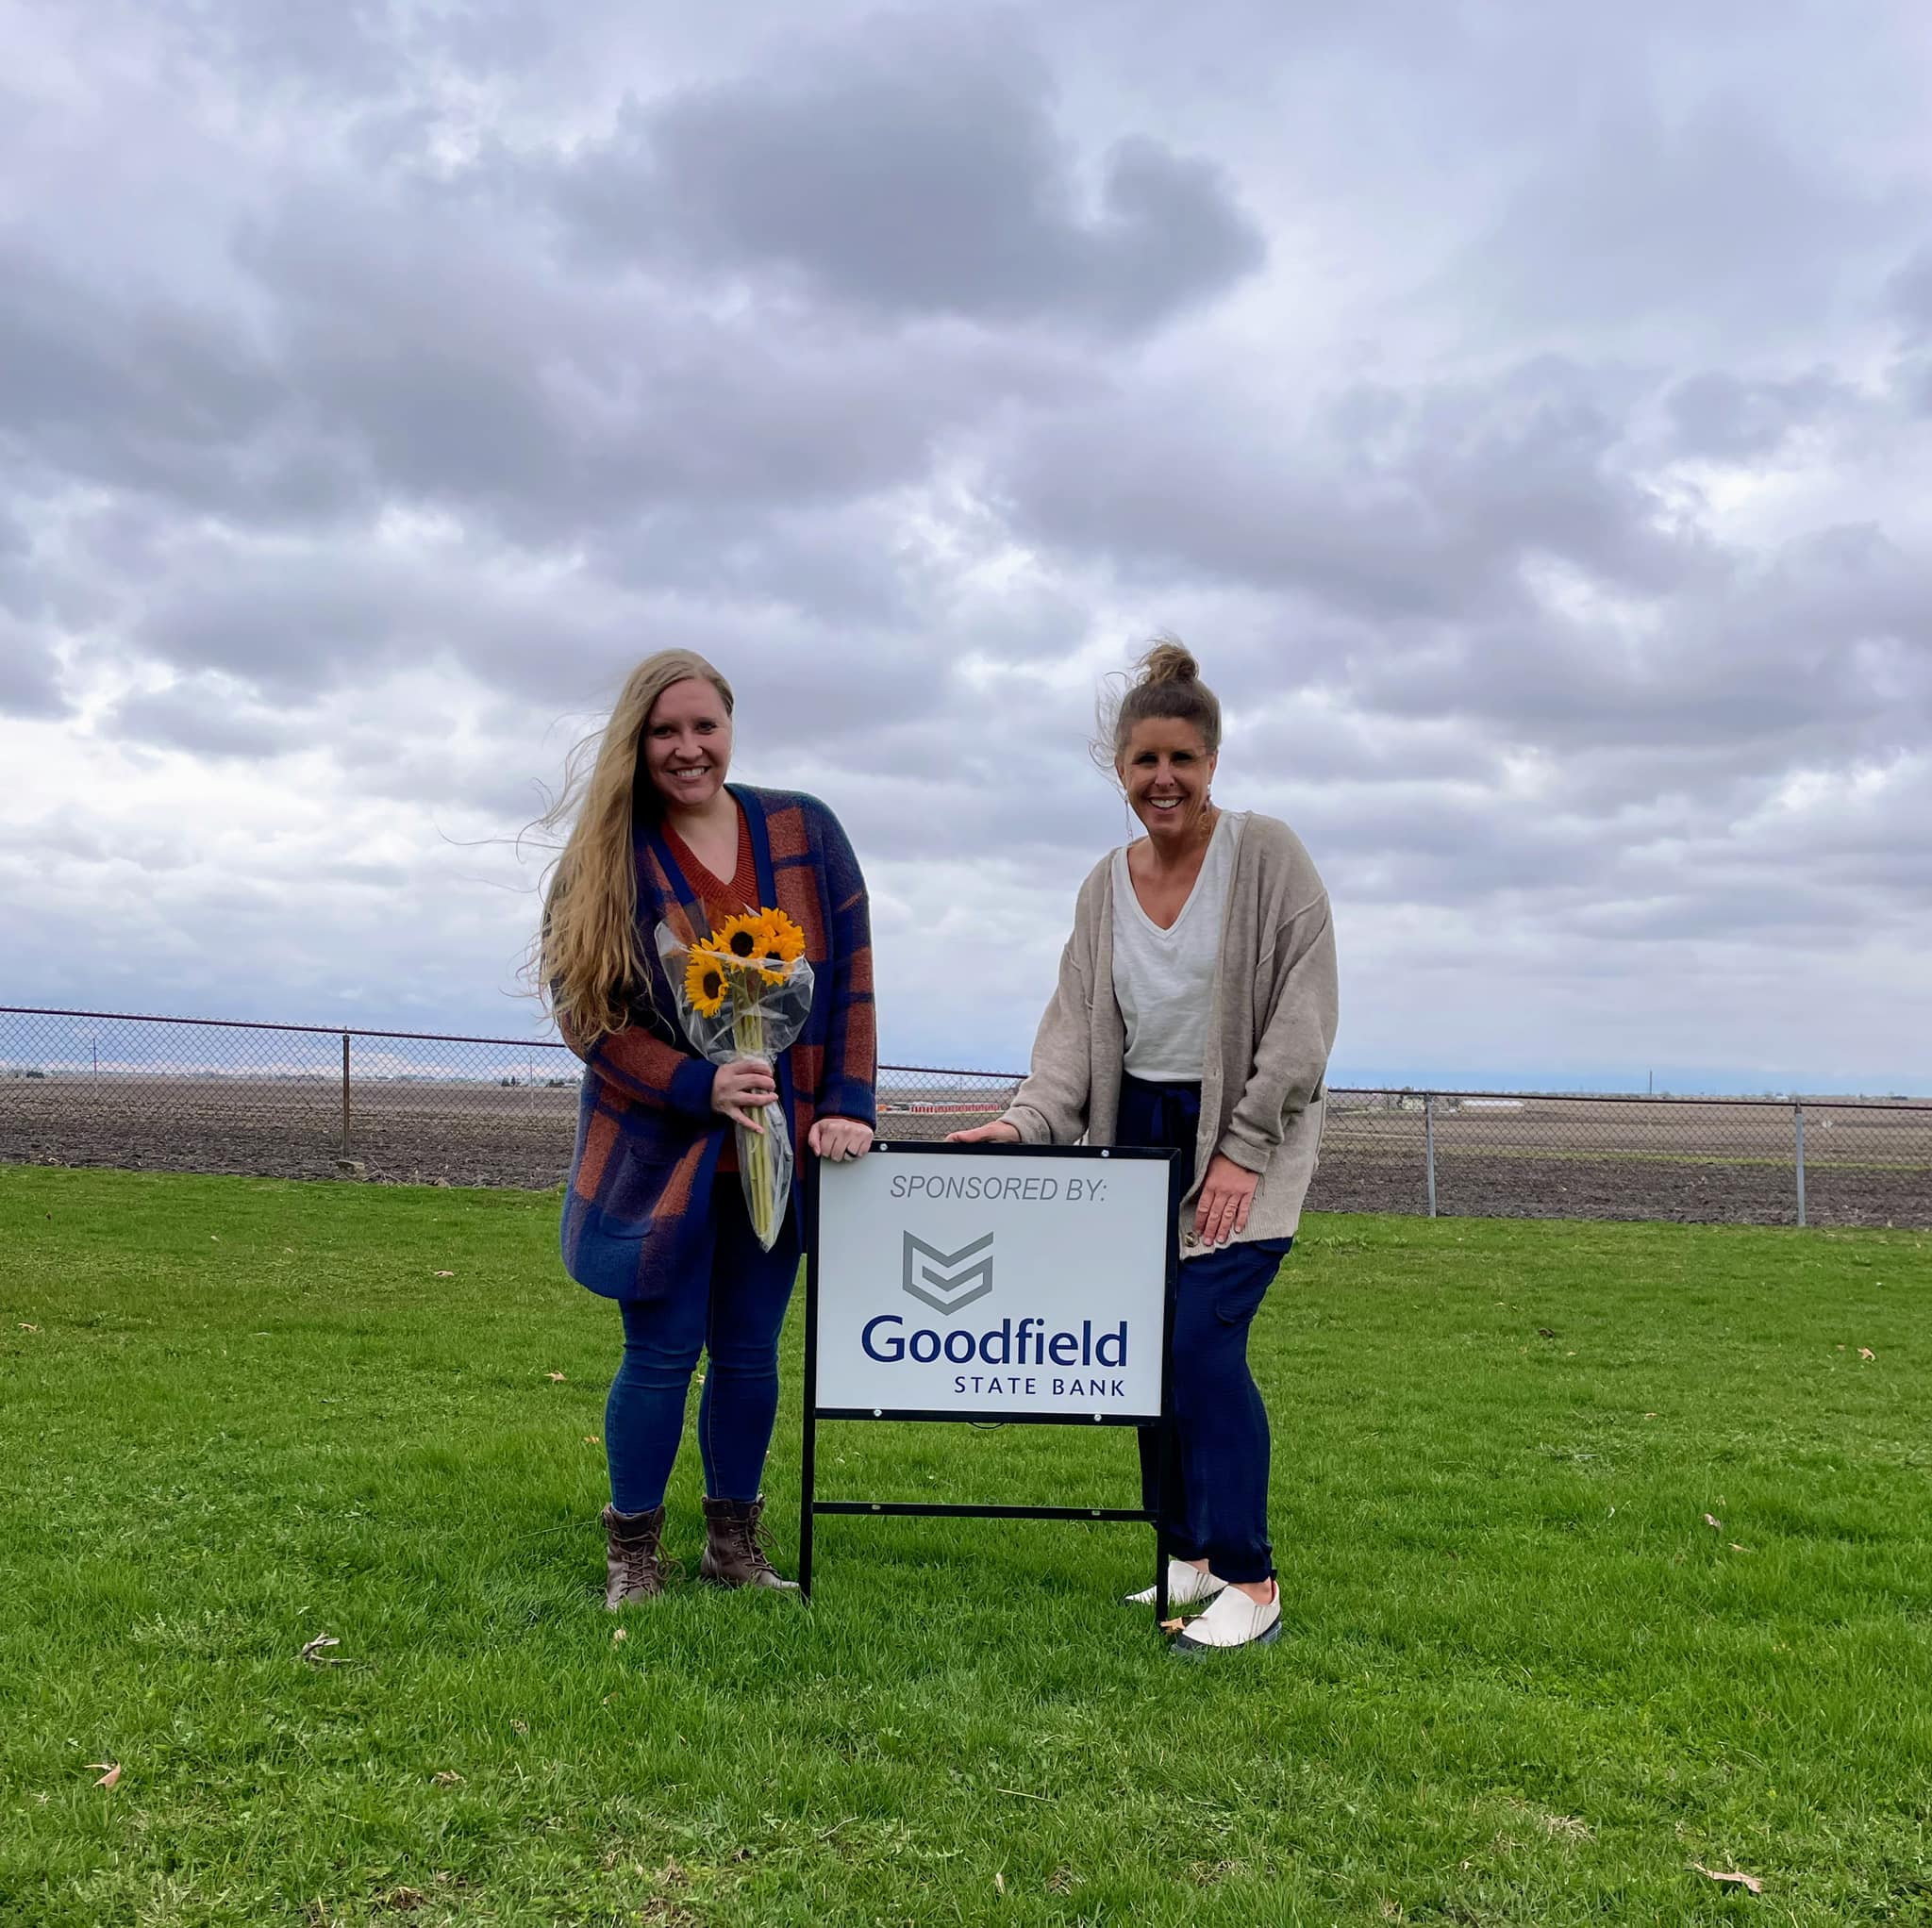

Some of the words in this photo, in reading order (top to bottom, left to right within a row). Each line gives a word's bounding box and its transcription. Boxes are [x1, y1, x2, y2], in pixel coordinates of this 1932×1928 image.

[890, 1175, 1058, 1201] SPONSORED
[1065, 1178, 1108, 1202] BY:
[861, 1314, 1127, 1367] Goodfield
[954, 1376, 1036, 1395] STATE
[1052, 1378, 1125, 1397] BANK
